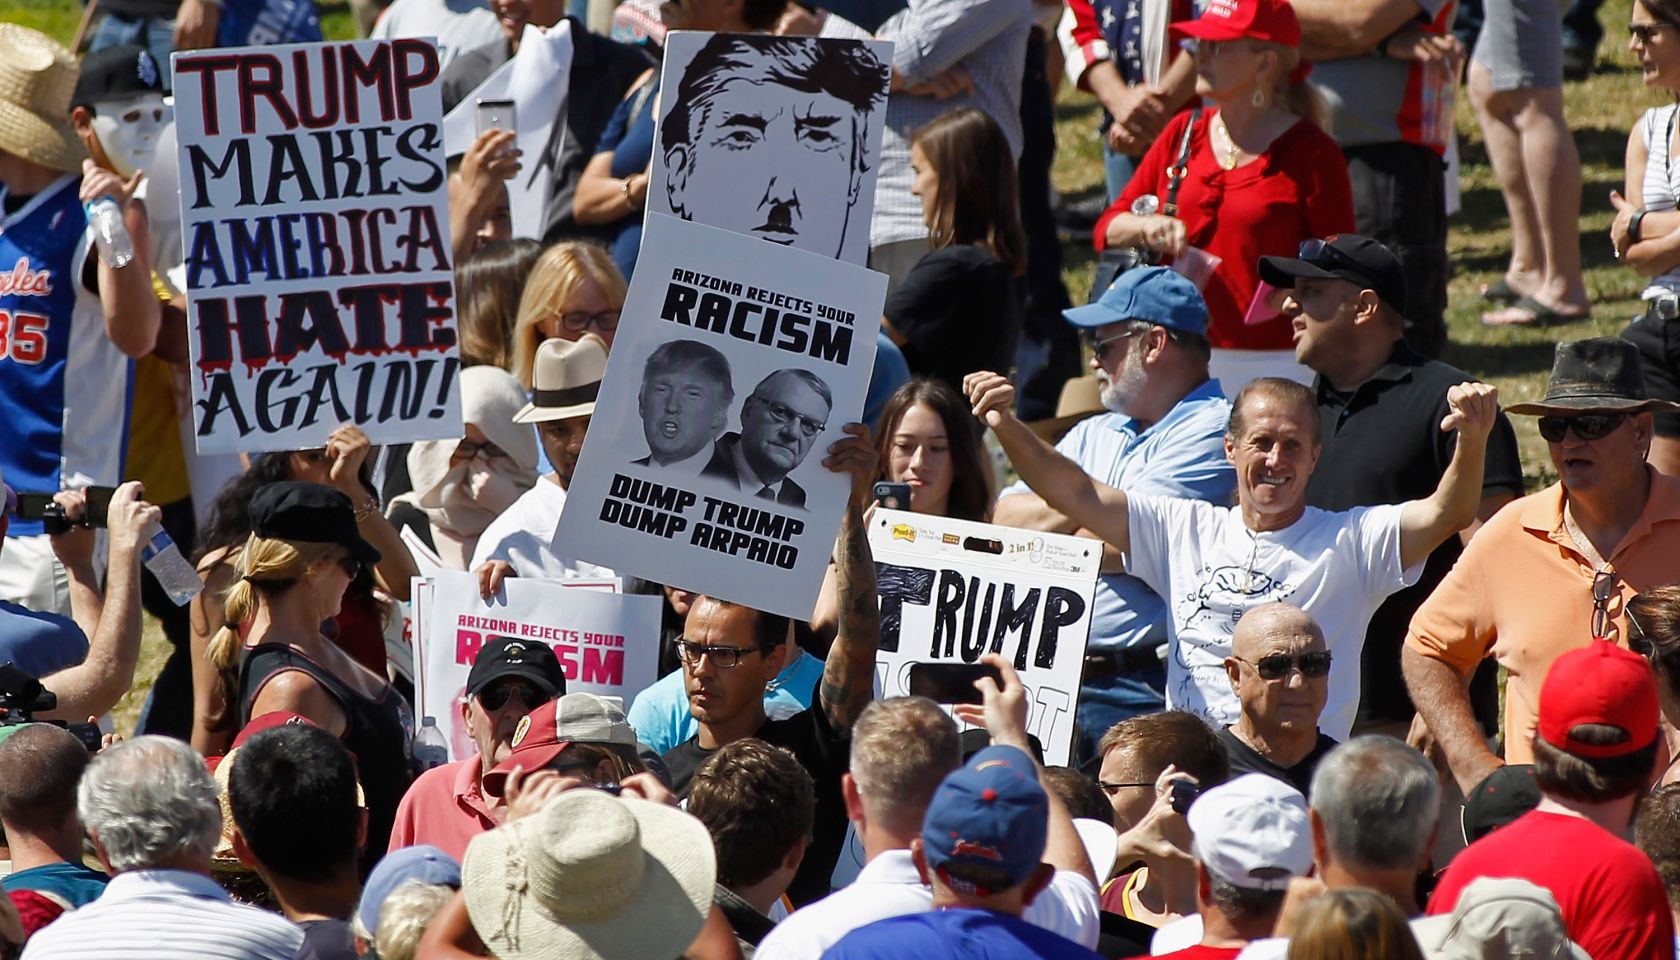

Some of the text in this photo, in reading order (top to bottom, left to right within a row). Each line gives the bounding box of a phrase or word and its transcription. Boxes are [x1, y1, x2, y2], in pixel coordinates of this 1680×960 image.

[175, 39, 440, 136] TRUMP
[185, 123, 444, 209] MAKES
[0, 256, 53, 297] eles
[184, 206, 454, 288] AMERICA
[194, 281, 457, 376] HATE
[660, 282, 854, 366] RACISM
[672, 268, 855, 326] ARIZONA REJECTS YOUR
[196, 357, 460, 437] AGAIN!
[599, 498, 799, 570] DUMP ARPAIO
[609, 473, 805, 542] DUMP TRUMP
[1009, 544, 1015, 553] 2
[1016, 543, 1025, 552] in
[458, 614, 625, 648] ARIZONA REJECTS YOUR
[875, 562, 1086, 671] TRUMP
[455, 629, 625, 686] RSM
